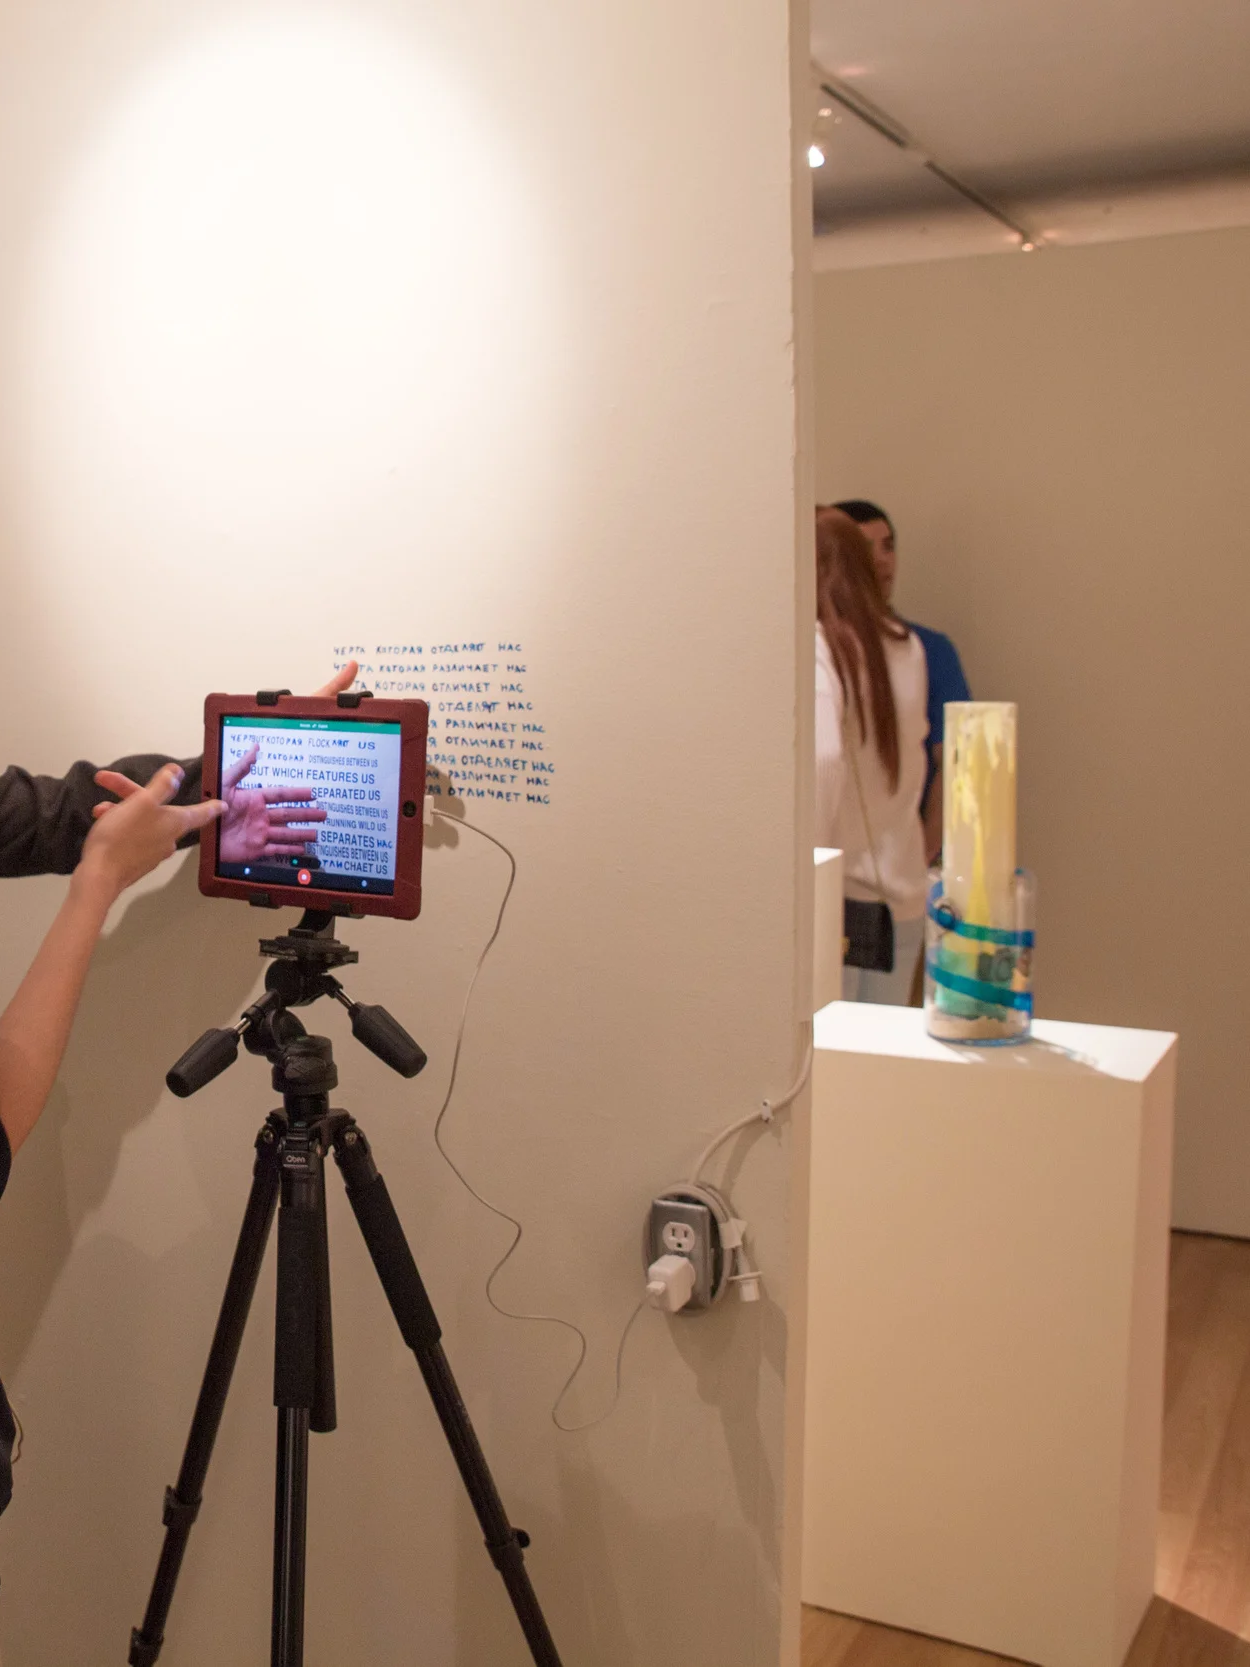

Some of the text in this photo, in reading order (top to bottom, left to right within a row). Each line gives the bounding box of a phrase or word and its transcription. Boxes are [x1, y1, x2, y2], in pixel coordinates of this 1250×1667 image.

[497, 643, 522, 652] НАС
[432, 664, 498, 673] РАЗЛИЧАЕТ
[506, 664, 527, 673] НАС
[375, 680, 425, 691] КОТОРАЯ
[432, 682, 490, 693] ОТЛИЧАЕТ
[500, 683, 523, 693] НАС
[507, 702, 533, 711] НАС
[445, 718, 518, 733] РАЗЛИЧАЕТ
[522, 723, 546, 733] НАС
[358, 741, 376, 750] US
[445, 735, 515, 749] ОТЛИЧАЕТ
[521, 740, 544, 751] НАС
[346, 757, 370, 768] BETWEEN
[371, 759, 379, 768] US
[461, 754, 528, 770] ОТДЕЛЯЕТ
[531, 760, 555, 773] НАС
[250, 765, 375, 785] BUT WHICH FEATURES US
[448, 769, 518, 783] РАЗЛИЧАЕТ
[526, 776, 550, 786] НАС
[311, 786, 381, 801] SEPARATED US
[448, 786, 521, 802] ОТЛИЧАЕТ
[526, 792, 551, 804] НАС
[354, 805, 381, 818] BETWEEN
[381, 809, 389, 819] US
[358, 820, 376, 831] WILD
[376, 822, 387, 832] US
[321, 830, 375, 849] SEPARATES
[350, 847, 379, 862] BETWEEN
[380, 851, 389, 864] US
[375, 864, 388, 875] US
